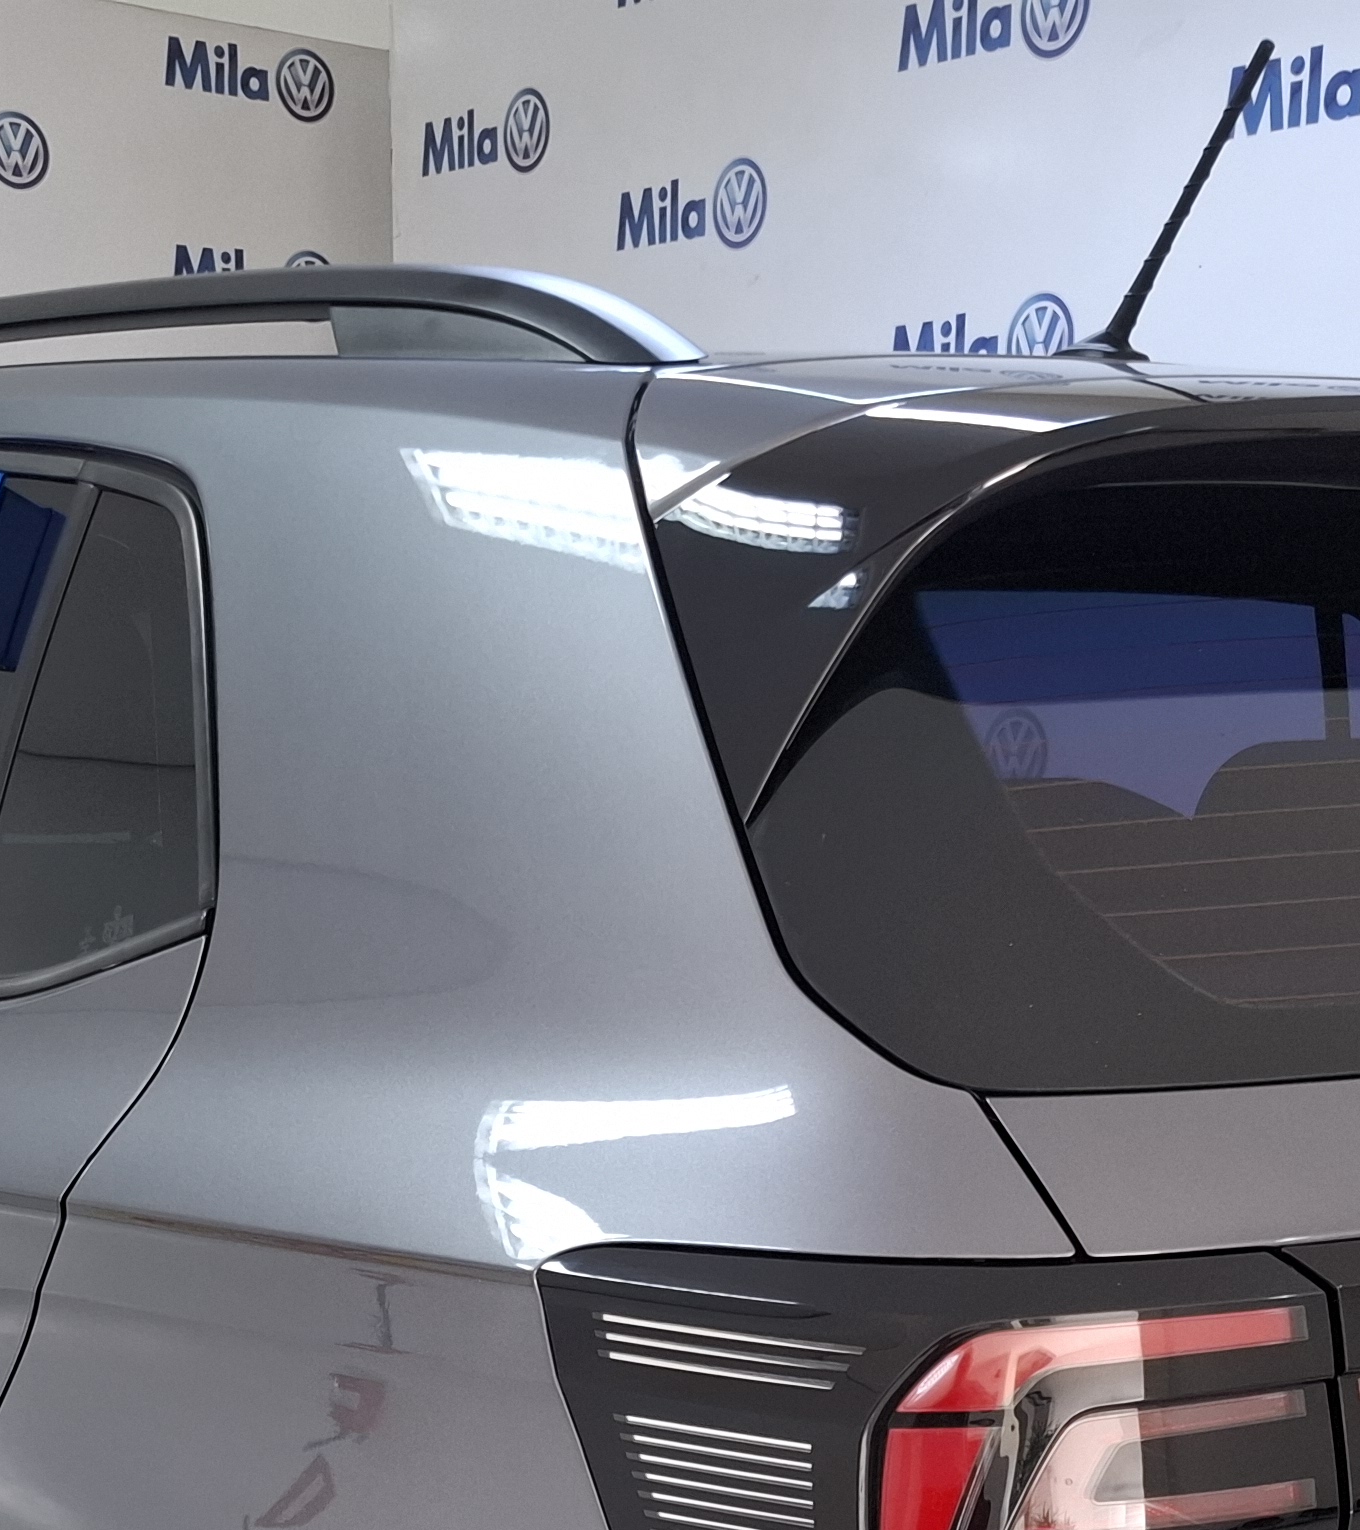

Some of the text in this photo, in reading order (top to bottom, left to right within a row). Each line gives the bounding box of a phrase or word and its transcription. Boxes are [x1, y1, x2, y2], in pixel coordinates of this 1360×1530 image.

[165, 36, 270, 101] Mila
[897, 0, 1011, 71] Mila
[422, 109, 498, 177] Mila
[616, 179, 706, 251] Mila
